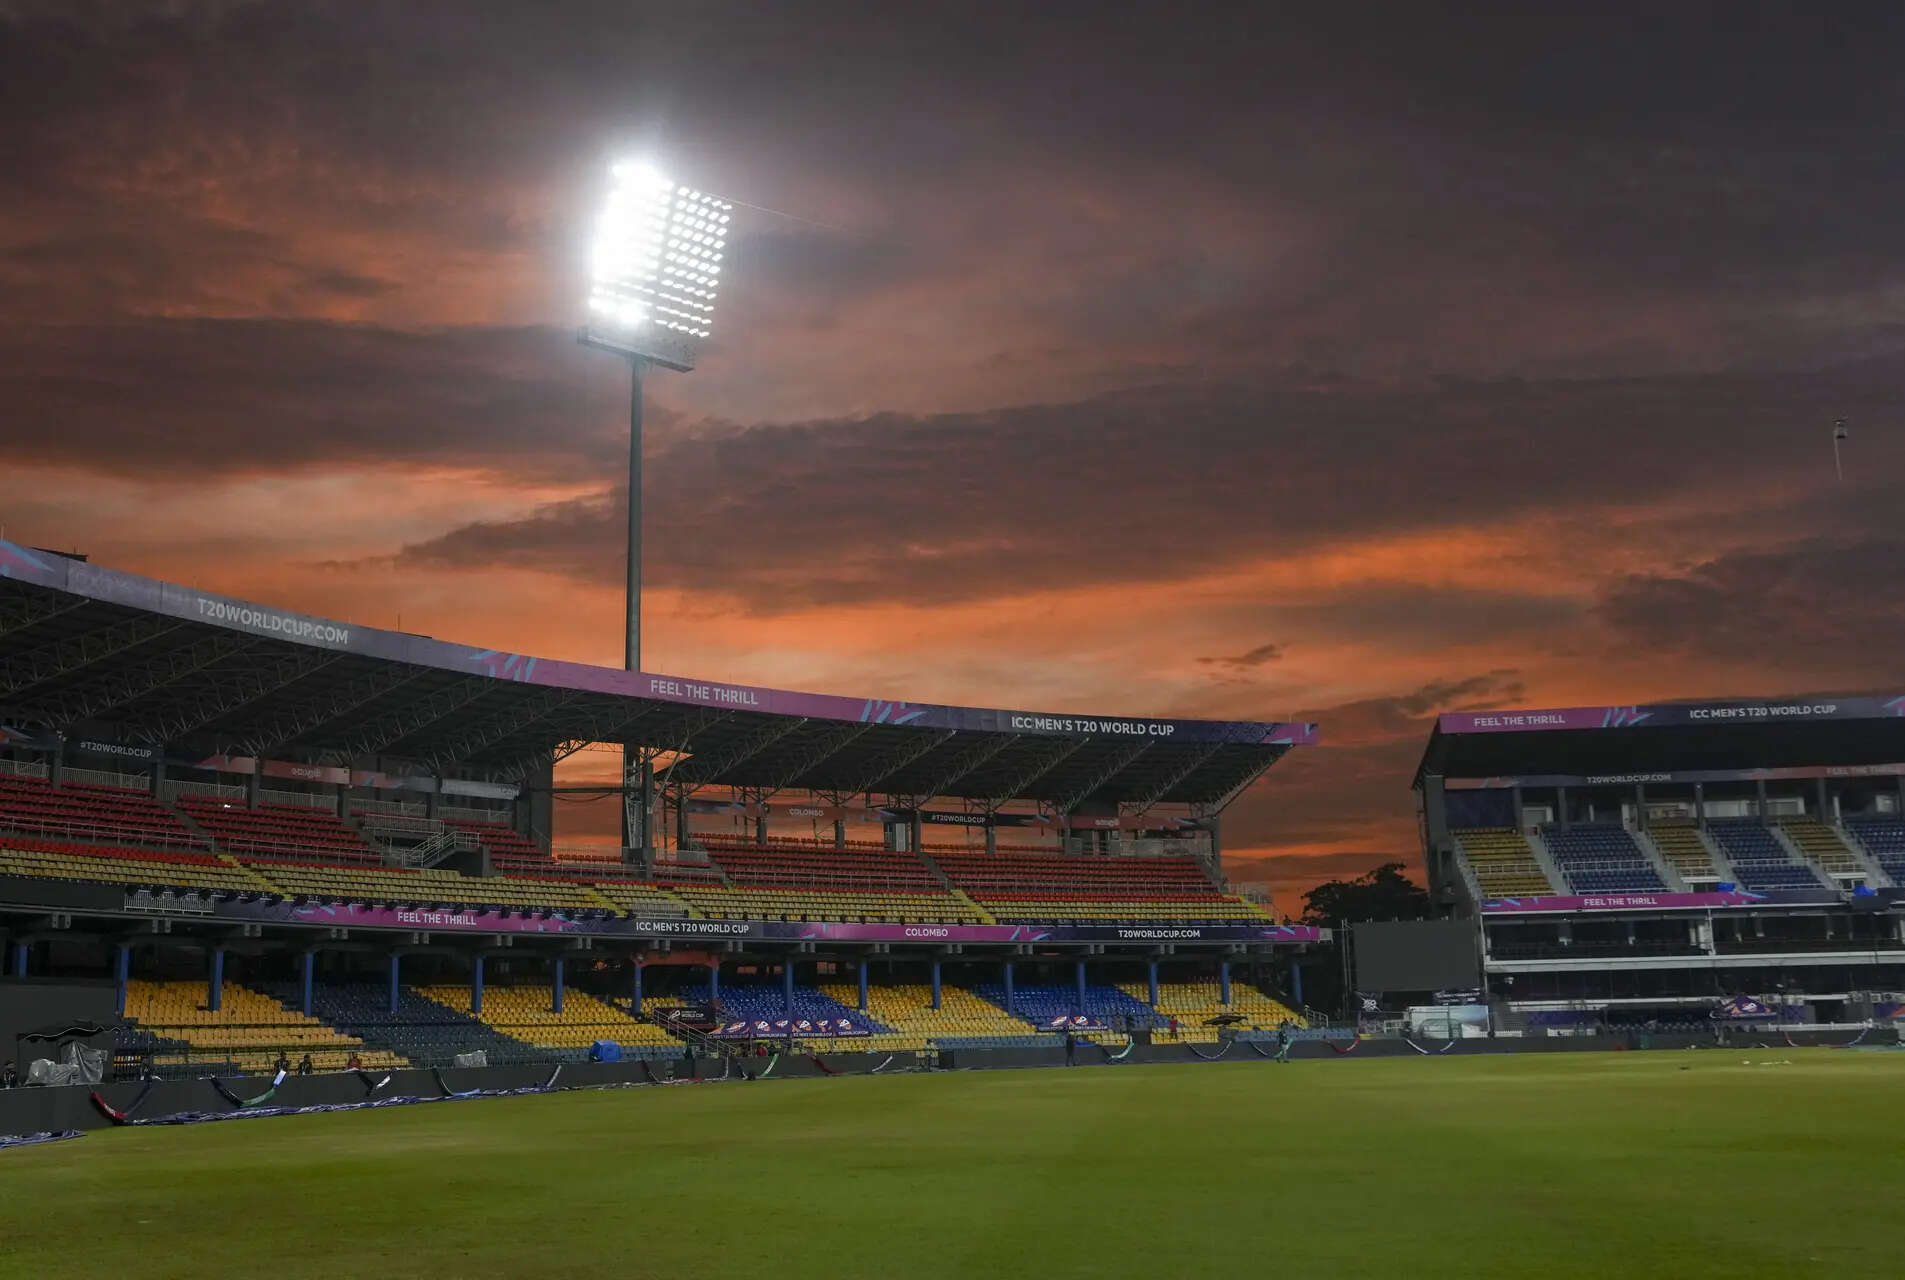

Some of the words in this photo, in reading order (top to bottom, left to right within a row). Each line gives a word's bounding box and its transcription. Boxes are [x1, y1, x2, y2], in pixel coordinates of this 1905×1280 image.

[198, 598, 349, 644] T20WORLDCUP.COM
[650, 680, 683, 696] FEEL
[685, 684, 709, 699] THE
[713, 688, 759, 705] THRILL
[1690, 709, 1709, 718] ICC
[1711, 707, 1745, 717] MEN'S
[1747, 707, 1768, 716] T20
[1769, 705, 1812, 715] WORLD
[1813, 704, 1836, 714] CUP
[1011, 716, 1033, 729] ICC
[1035, 718, 1072, 731] MEN'S
[1074, 720, 1097, 732] T20
[1099, 721, 1146, 735] WORLD
[1149, 724, 1174, 736] CUP
[1474, 717, 1502, 727] FEEL
[1503, 716, 1525, 726] THE
[1526, 714, 1566, 725] THRILL
[80, 741, 152, 758] #T20WORLDCUP
[1586, 774, 1672, 784] T20WORLDCUP.COM
[1583, 898, 1606, 906] FEEL
[1626, 897, 1658, 905] THRILL
[397, 911, 420, 923] FEEL
[422, 913, 441, 924] THE
[443, 915, 477, 926] THRILL
[635, 921, 651, 931] ICC
[653, 922, 679, 932] MEN'S
[680, 923, 697, 932] T20
[699, 923, 730, 933] WORLD
[731, 924, 749, 934] CUP
[905, 928, 948, 937] COLOMBO
[1118, 929, 1201, 938] T20WORLDCUP.COM
